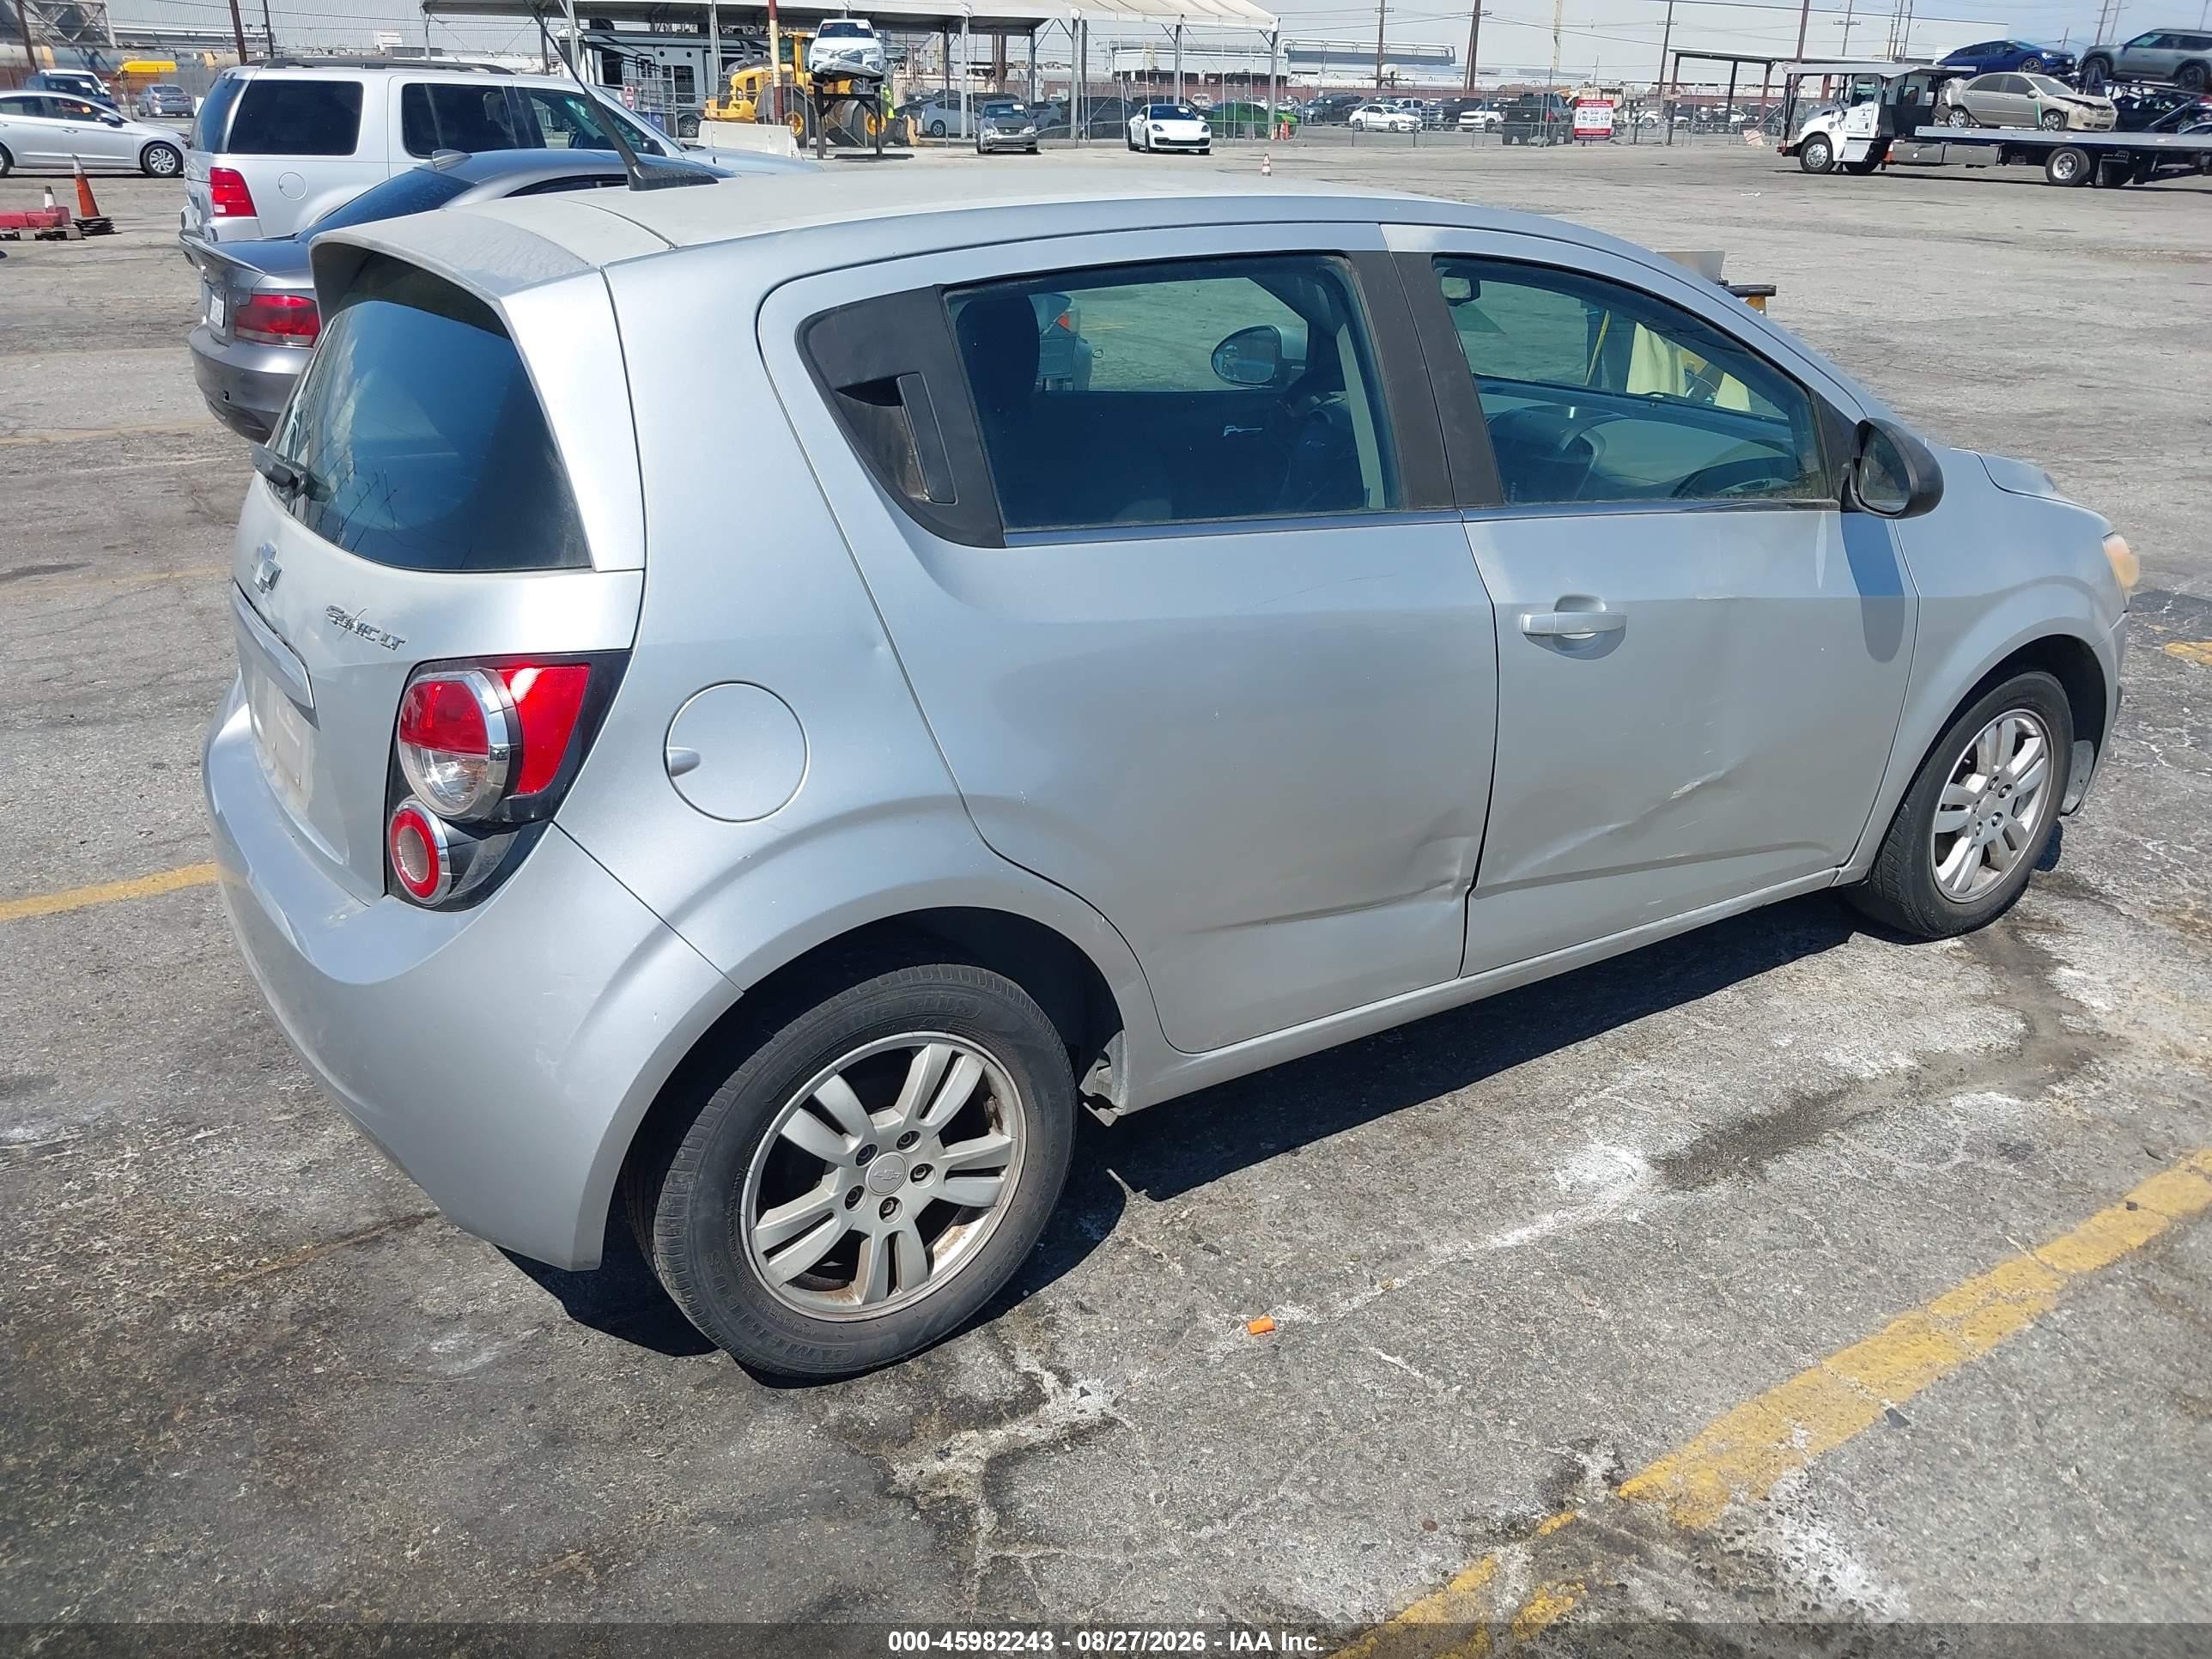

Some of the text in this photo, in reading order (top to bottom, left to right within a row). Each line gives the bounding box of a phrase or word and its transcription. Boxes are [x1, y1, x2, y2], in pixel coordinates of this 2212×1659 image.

[325, 605, 406, 650] SONIC LT
[907, 994, 974, 1015] PLUS
